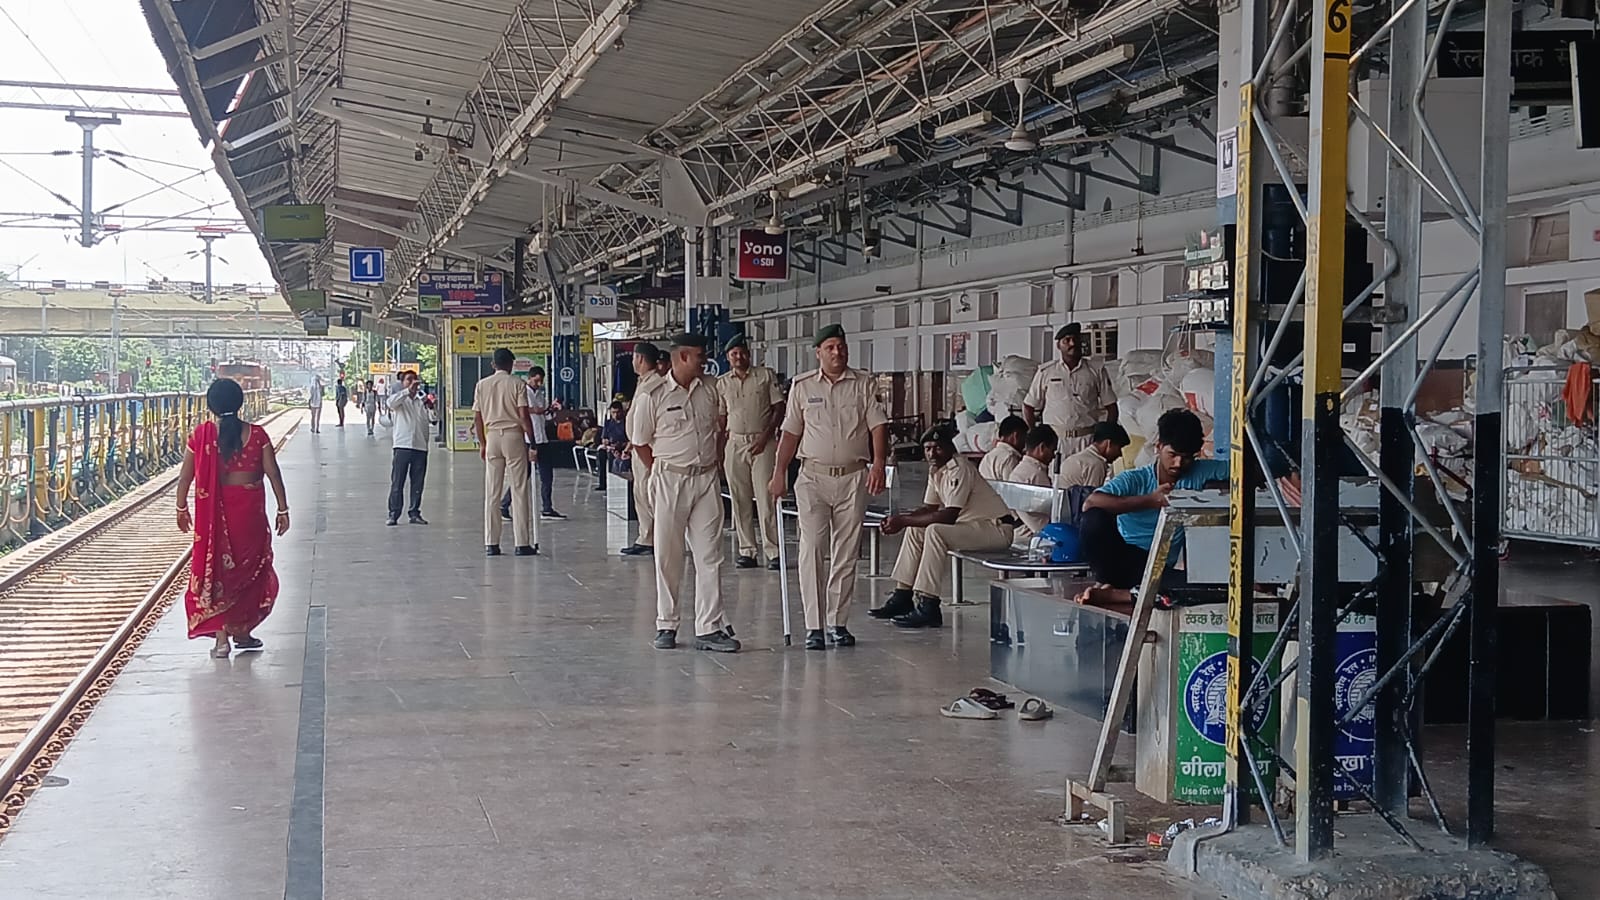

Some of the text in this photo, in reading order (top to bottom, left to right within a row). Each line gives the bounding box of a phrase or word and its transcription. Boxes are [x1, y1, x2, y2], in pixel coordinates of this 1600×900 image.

[1328, 0, 1349, 33] 6
[361, 253, 374, 276] 1
[760, 257, 775, 267] SBI
[347, 310, 356, 325] 1
[1209, 610, 1223, 626] रेल
[1180, 755, 1226, 777] गीला
[1181, 786, 1199, 796] Use
[1199, 786, 1212, 796] for
